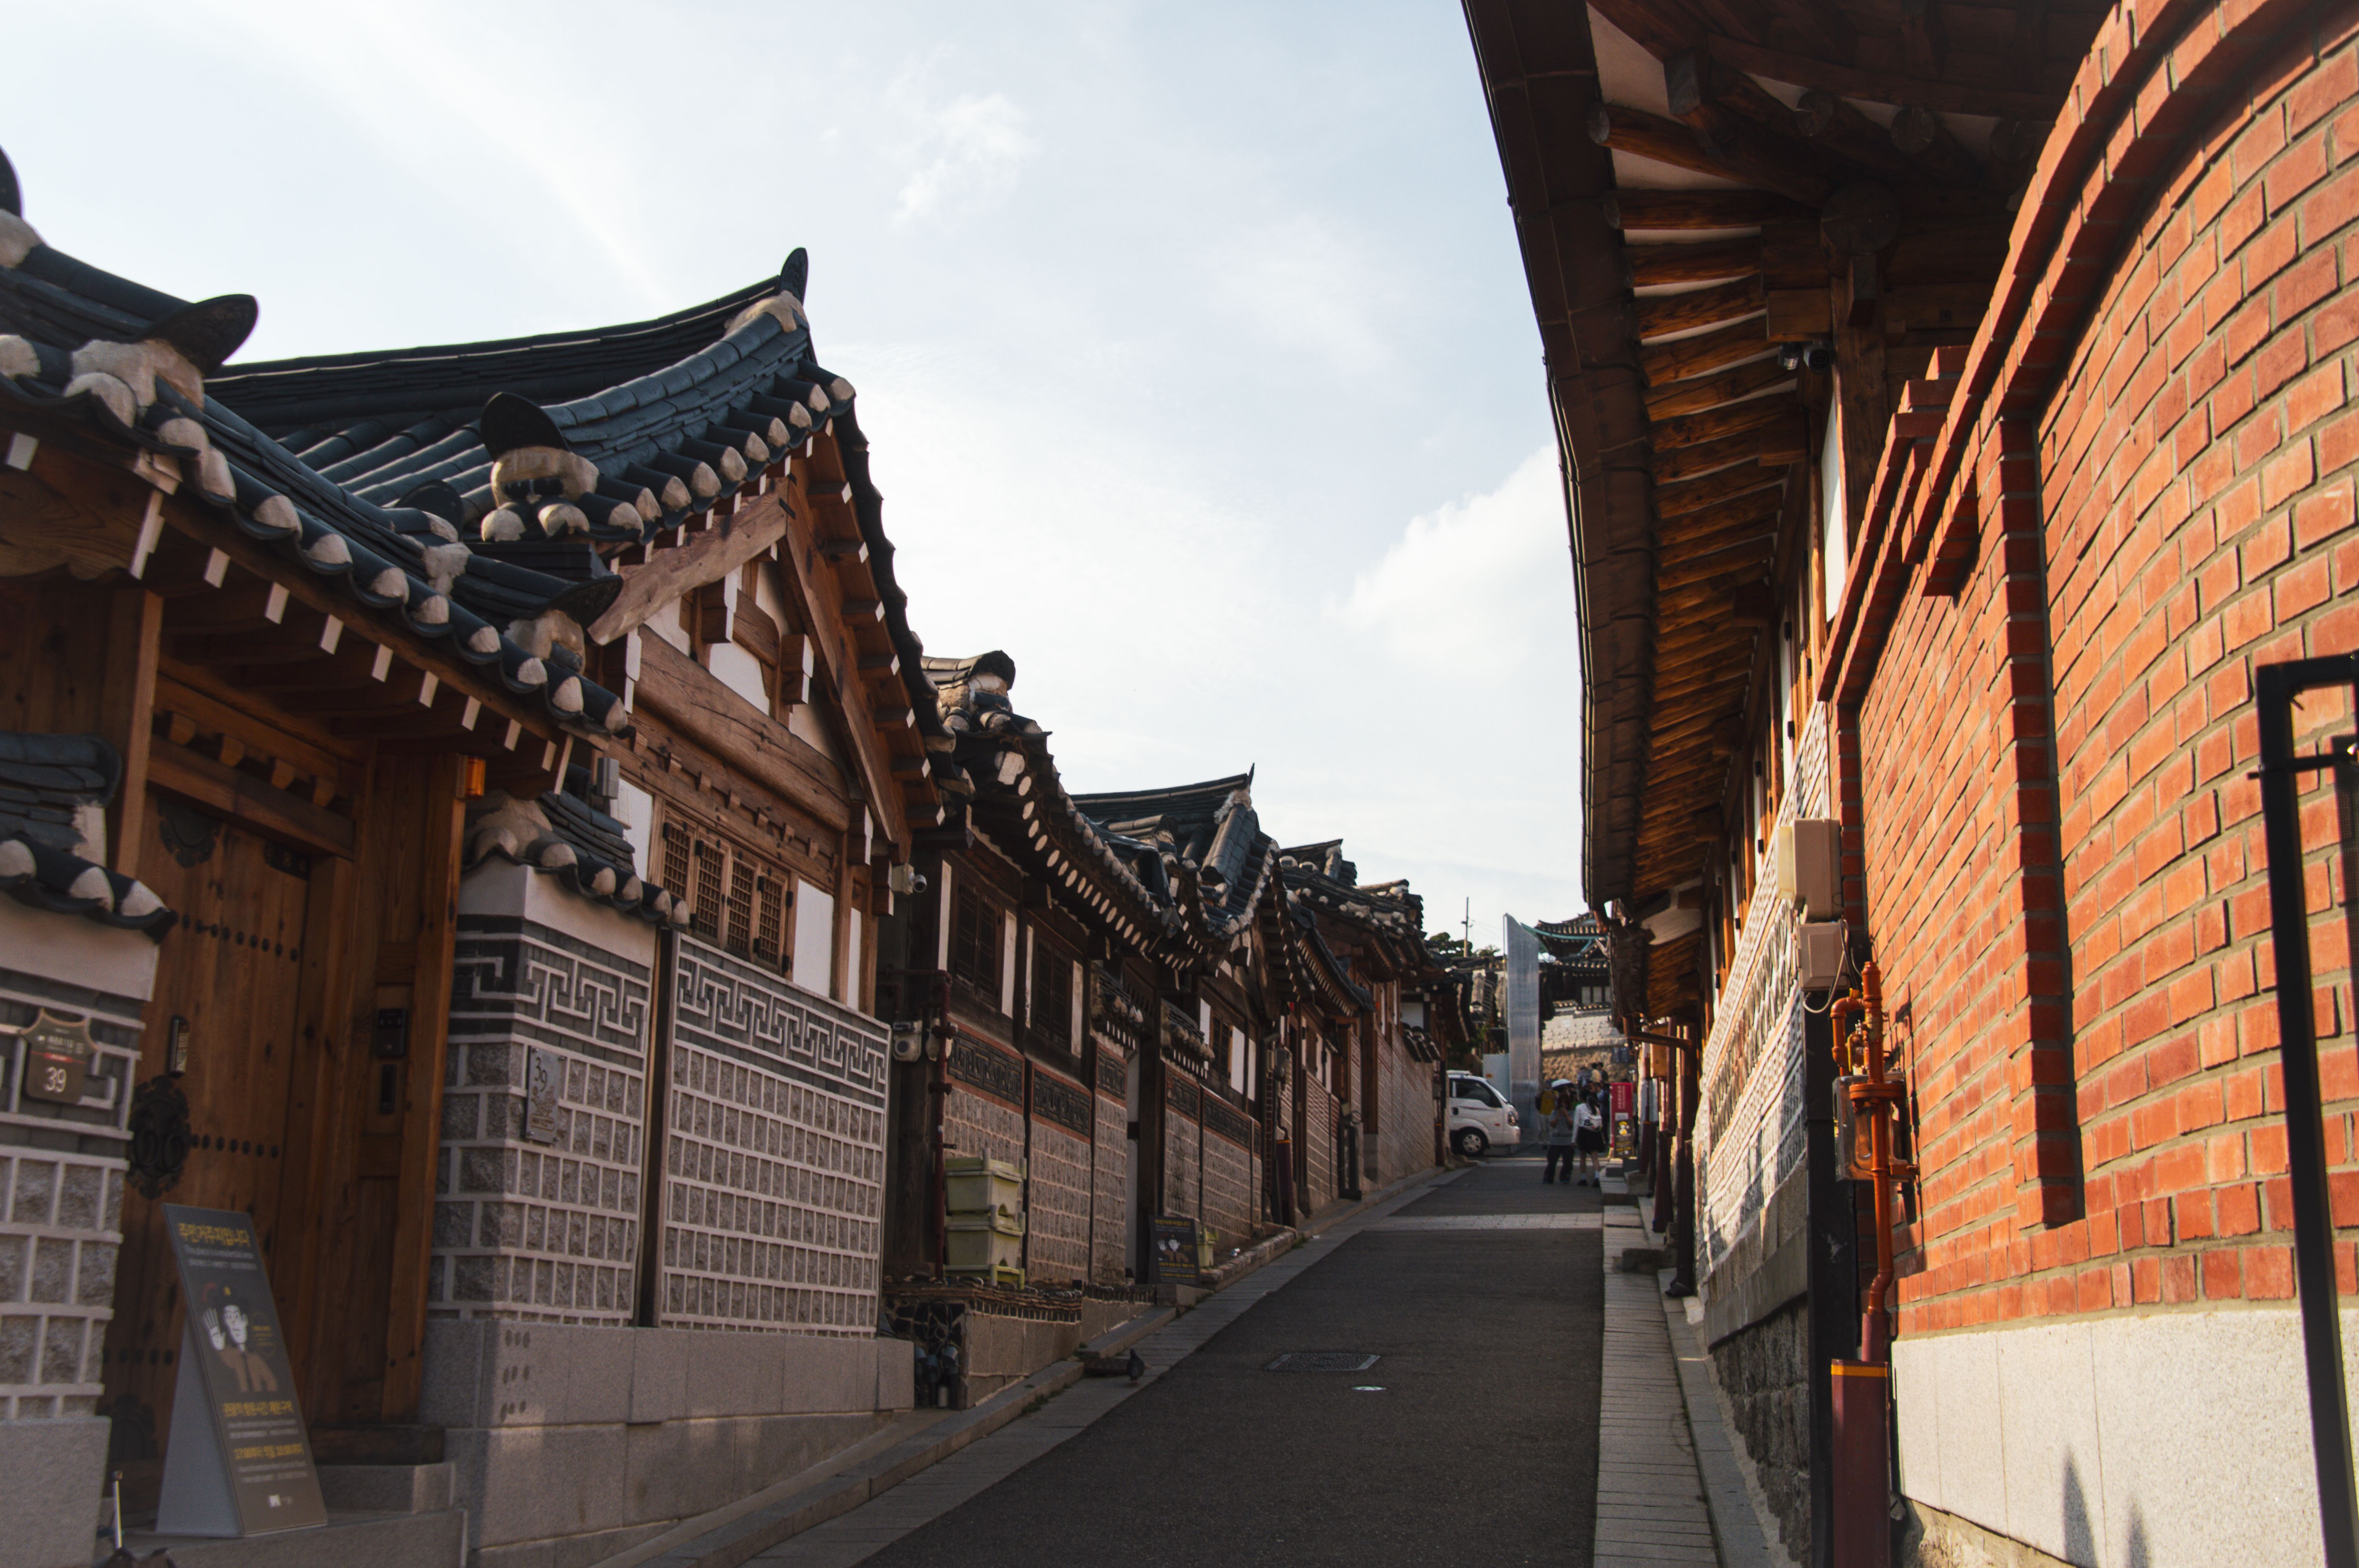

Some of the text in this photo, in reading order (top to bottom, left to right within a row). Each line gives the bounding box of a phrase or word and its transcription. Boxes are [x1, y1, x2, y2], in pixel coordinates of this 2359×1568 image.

[43, 1066, 67, 1093] 39
[534, 1057, 548, 1092] 39
[177, 1222, 251, 1247] 주민거주지입니다
